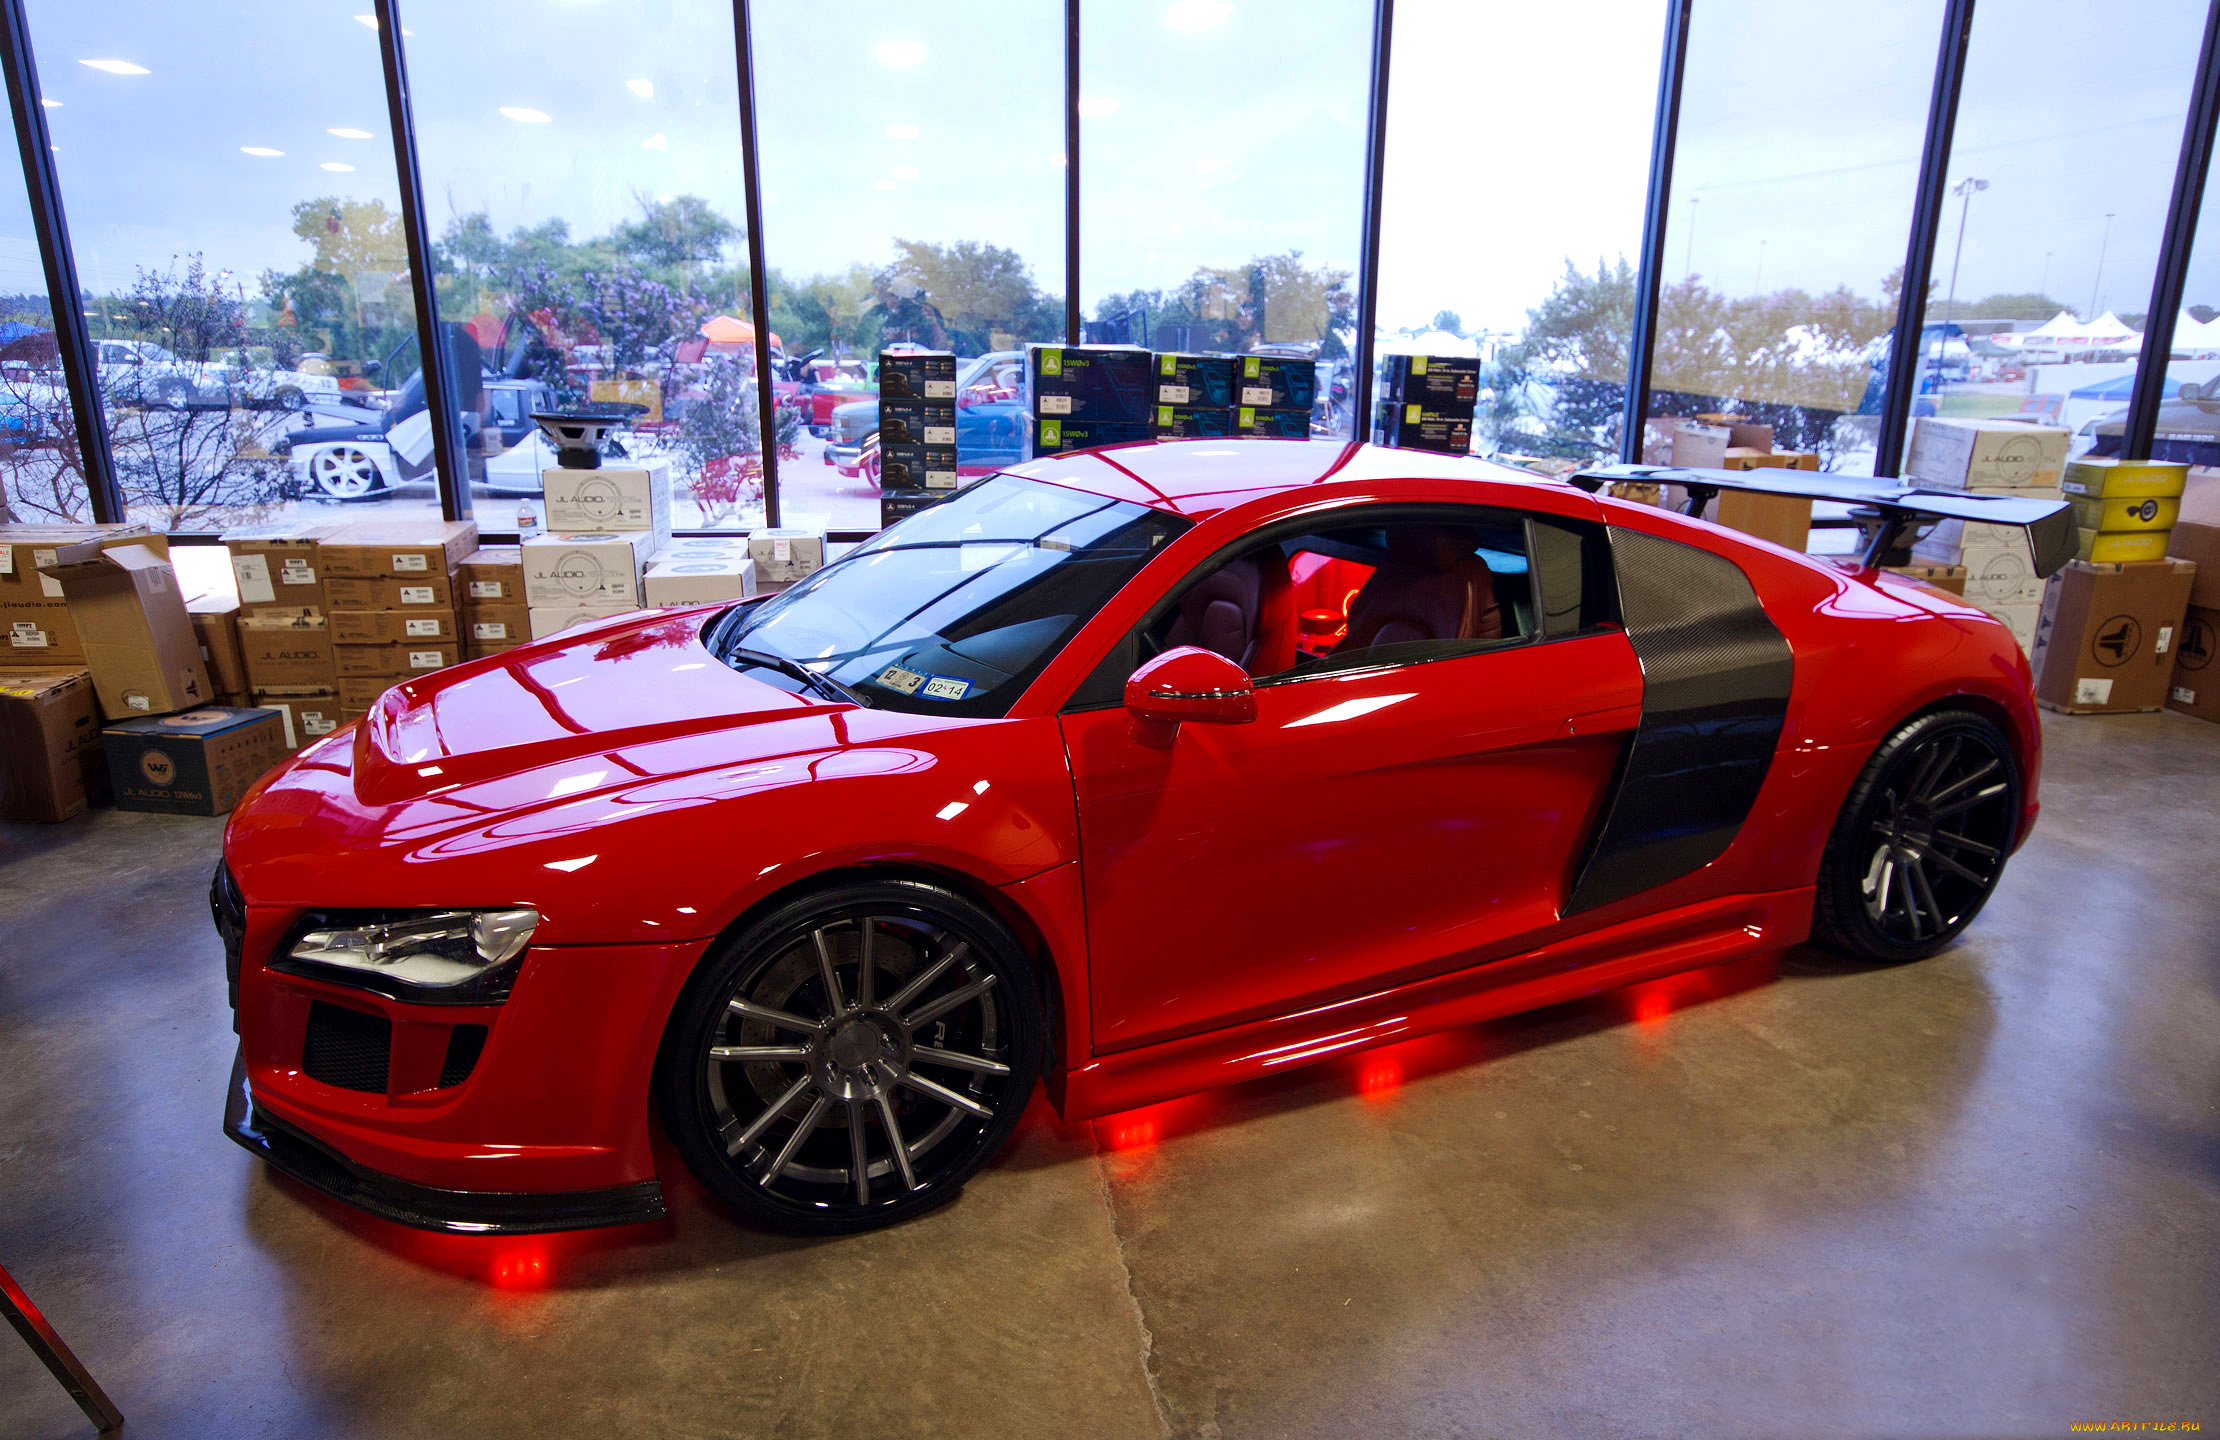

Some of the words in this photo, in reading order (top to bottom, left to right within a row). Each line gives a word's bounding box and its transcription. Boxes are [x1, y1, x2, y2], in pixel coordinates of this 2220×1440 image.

[2138, 474, 2169, 482] AUDIO
[555, 495, 568, 503] JL
[570, 495, 605, 503] AUDIO
[2123, 538, 2153, 546] AUDIO
[534, 571, 547, 579] JL
[550, 570, 585, 579] AUDIO
[262, 651, 275, 660] JL
[279, 650, 318, 659] AUDIO
[138, 789, 170, 798] AUDIO
